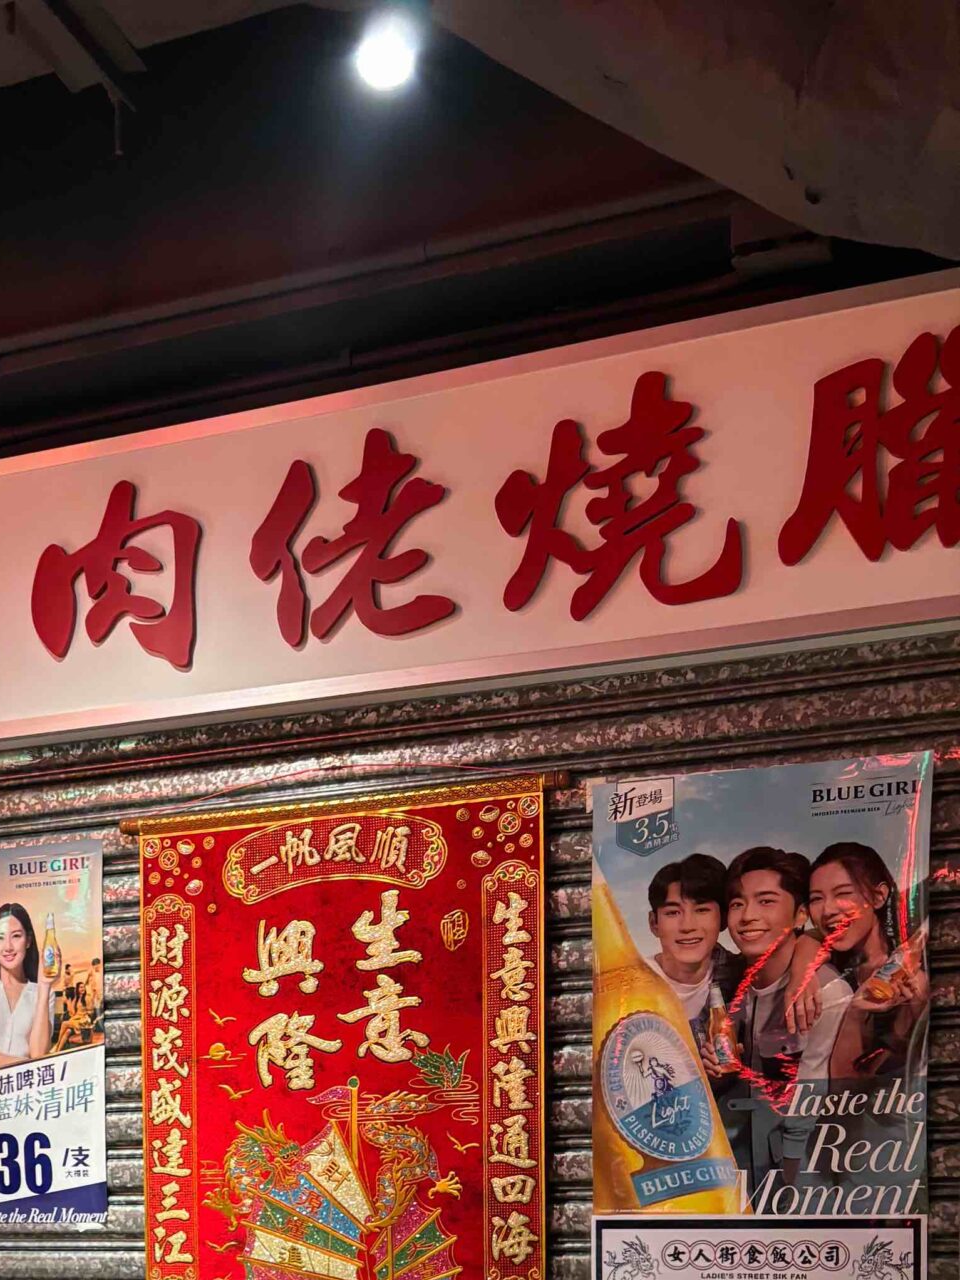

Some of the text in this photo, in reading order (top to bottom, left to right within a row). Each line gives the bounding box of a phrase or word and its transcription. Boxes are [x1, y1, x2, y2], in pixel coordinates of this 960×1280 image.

[607, 787, 663, 821] 新登場
[811, 779, 921, 803] BLUE GIRL
[8, 856, 90, 877] BLUE GIRL
[249, 822, 412, 875] 一帆風順
[337, 888, 431, 1063] 生意
[241, 919, 343, 1091] 興隆
[149, 923, 194, 1265] 財源茂盛達三江
[489, 891, 539, 1265] 生意興隆通四海
[782, 1078, 925, 1117] Taste the
[650, 1096, 691, 1129] Light
[624, 1115, 676, 1154] PILSENER
[800, 1121, 925, 1174] Real
[640, 1169, 695, 1197] BLUE
[733, 1168, 926, 1216] Moment
[8, 1207, 25, 1224] the
[26, 1206, 58, 1224] Real
[57, 1207, 108, 1224] Moment
[666, 1245, 842, 1267] 女人街食飯公司
[736, 1272, 771, 1280] STREET
[772, 1273, 788, 1280] SIK
[790, 1273, 808, 1280] FAN
